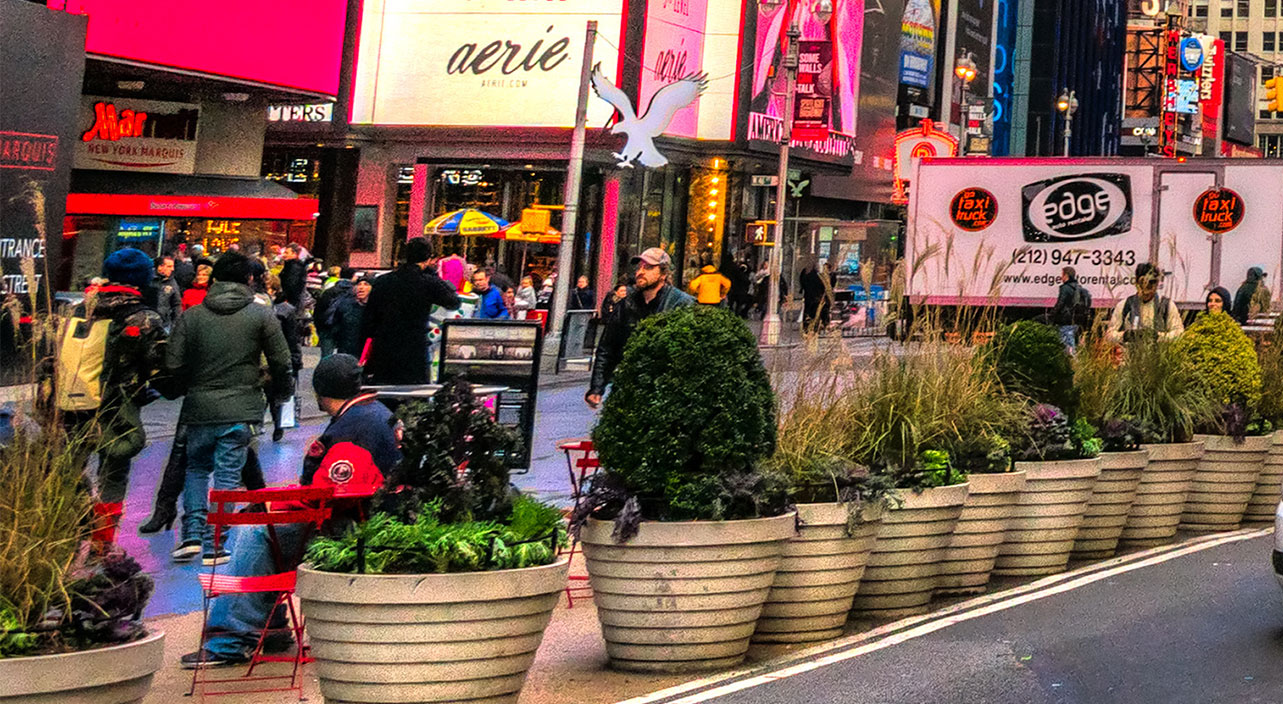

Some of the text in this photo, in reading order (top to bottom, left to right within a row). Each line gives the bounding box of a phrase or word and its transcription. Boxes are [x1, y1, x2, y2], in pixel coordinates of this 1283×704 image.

[446, 25, 570, 75] aerie
[0, 140, 56, 163] ARQUIS
[88, 144, 109, 155] NEW
[959, 196, 990, 209] taxi
[1043, 191, 1110, 224] edge
[1203, 197, 1236, 210] taxi
[956, 209, 987, 220] truck
[1200, 211, 1234, 222] truck
[0, 238, 46, 258] TRANCE
[1012, 248, 1137, 266] (212) 947-3343
[0, 274, 42, 294] STRET
